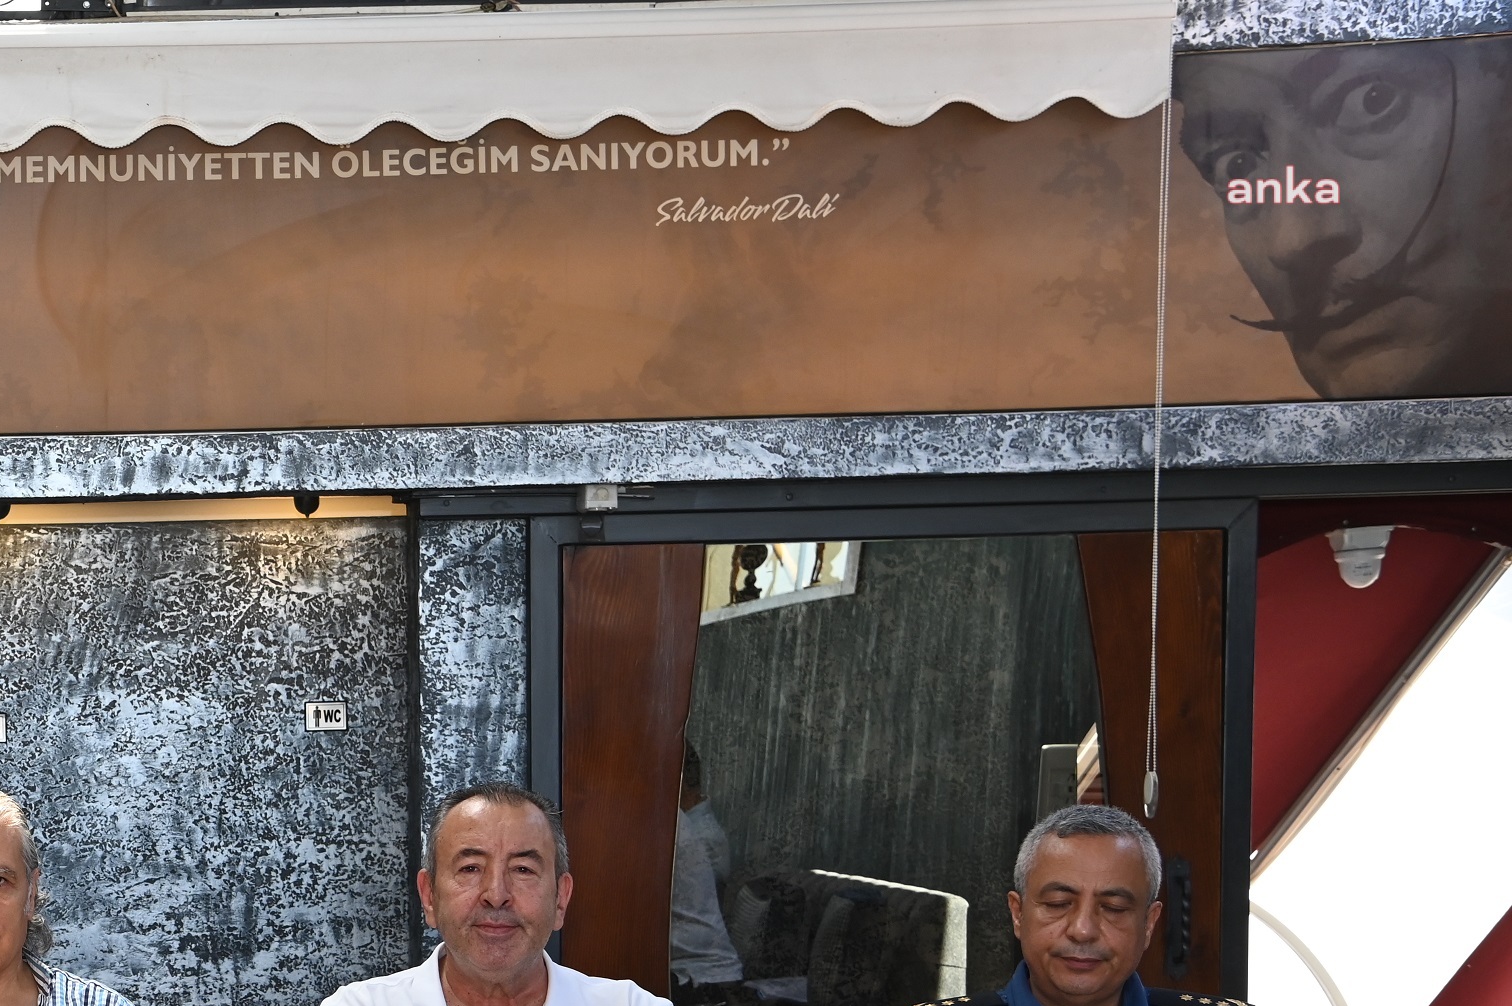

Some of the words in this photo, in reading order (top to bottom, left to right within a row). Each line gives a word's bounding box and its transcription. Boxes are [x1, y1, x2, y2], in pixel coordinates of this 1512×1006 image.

[530, 138, 790, 172] SANIYORUM.”
[655, 196, 771, 227] Salvador
[323, 709, 341, 723] WC
